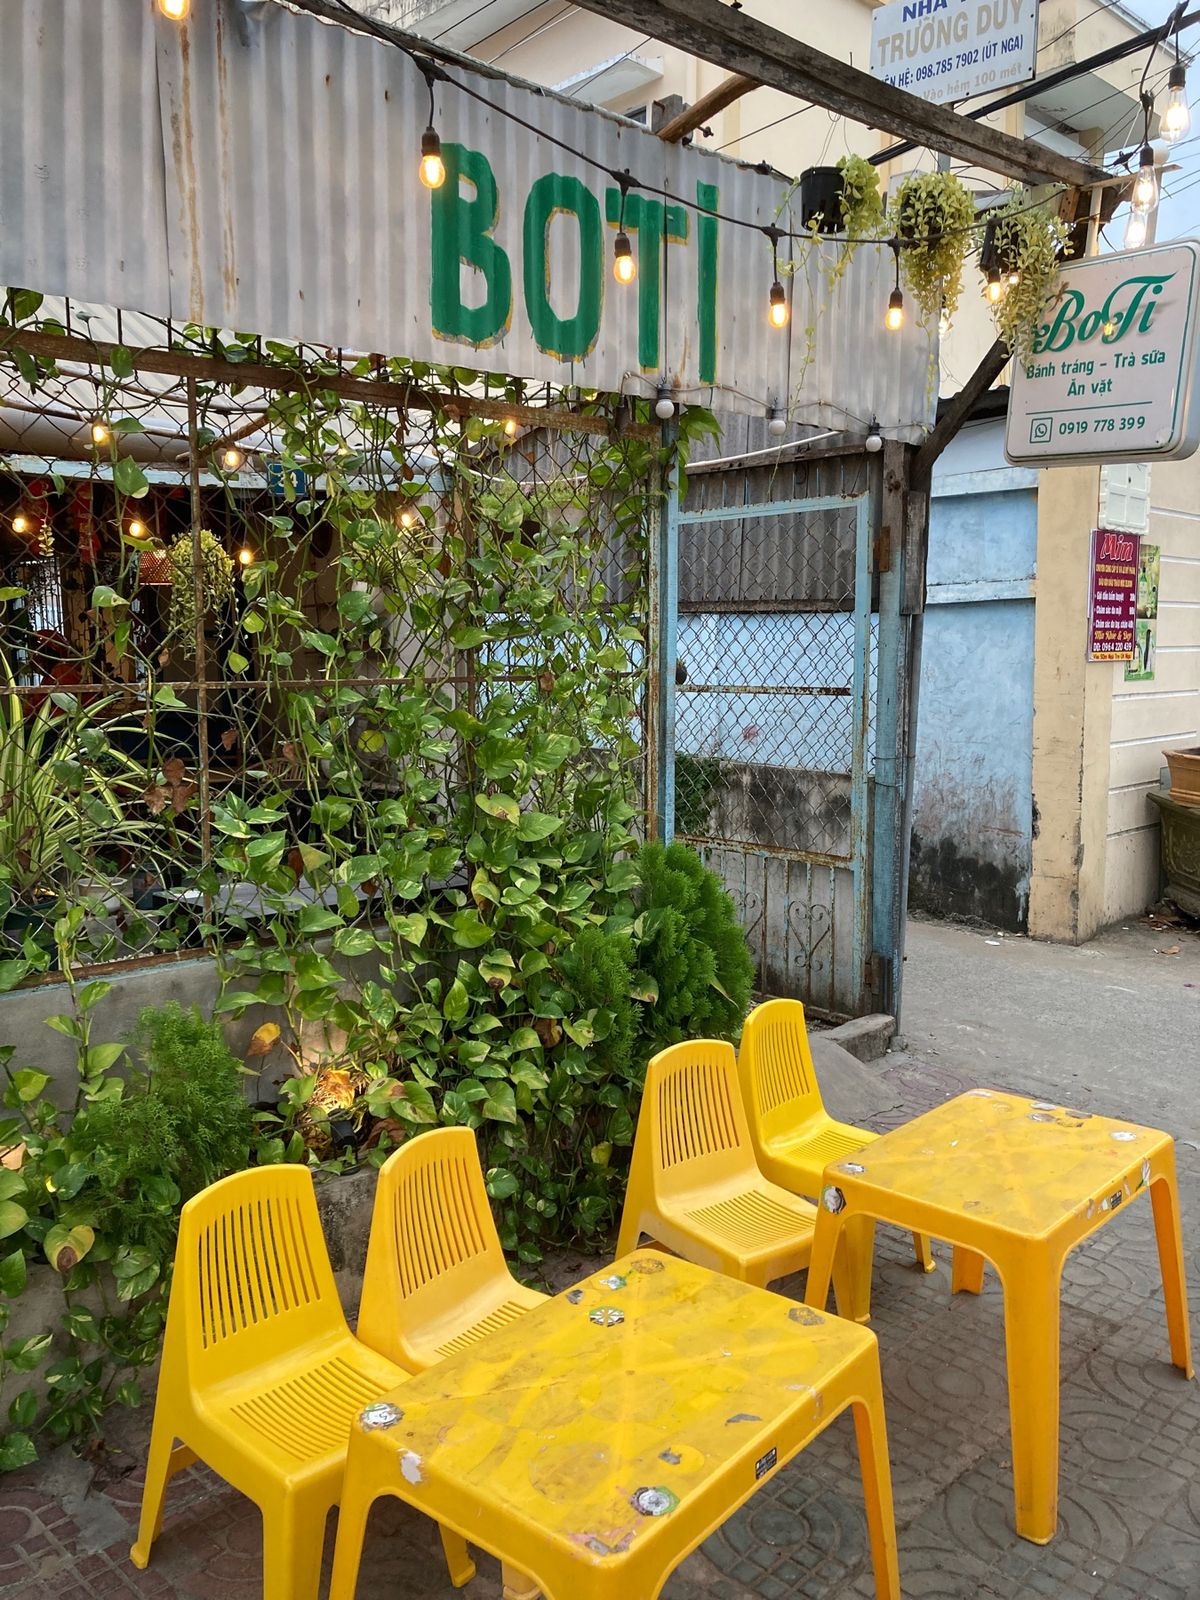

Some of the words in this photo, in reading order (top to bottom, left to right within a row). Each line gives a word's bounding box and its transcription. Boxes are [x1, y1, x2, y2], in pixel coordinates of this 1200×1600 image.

[976, 0, 1024, 36] DUY
[898, 67, 914, 88] HỆ:
[916, 58, 953, 82] 098.785
[956, 49, 979, 69] 7902
[982, 40, 998, 62] (ÚT
[1001, 34, 1024, 54] NGA)
[975, 69, 996, 87] 100
[430, 142, 720, 386] BOTI
[1032, 271, 1177, 354] BoTi
[1026, 361, 1056, 379] Bánh
[1061, 358, 1095, 376] tráng
[1114, 351, 1136, 368] Trà
[1141, 349, 1166, 366] sữa
[1067, 378, 1085, 396] Ăn
[1091, 378, 1113, 397] vặt
[1059, 421, 1088, 435] 0919
[1093, 419, 1115, 432] 778
[1100, 533, 1133, 562] Min
[1101, 642, 1114, 652] 0964
[1115, 642, 1123, 651] 220
